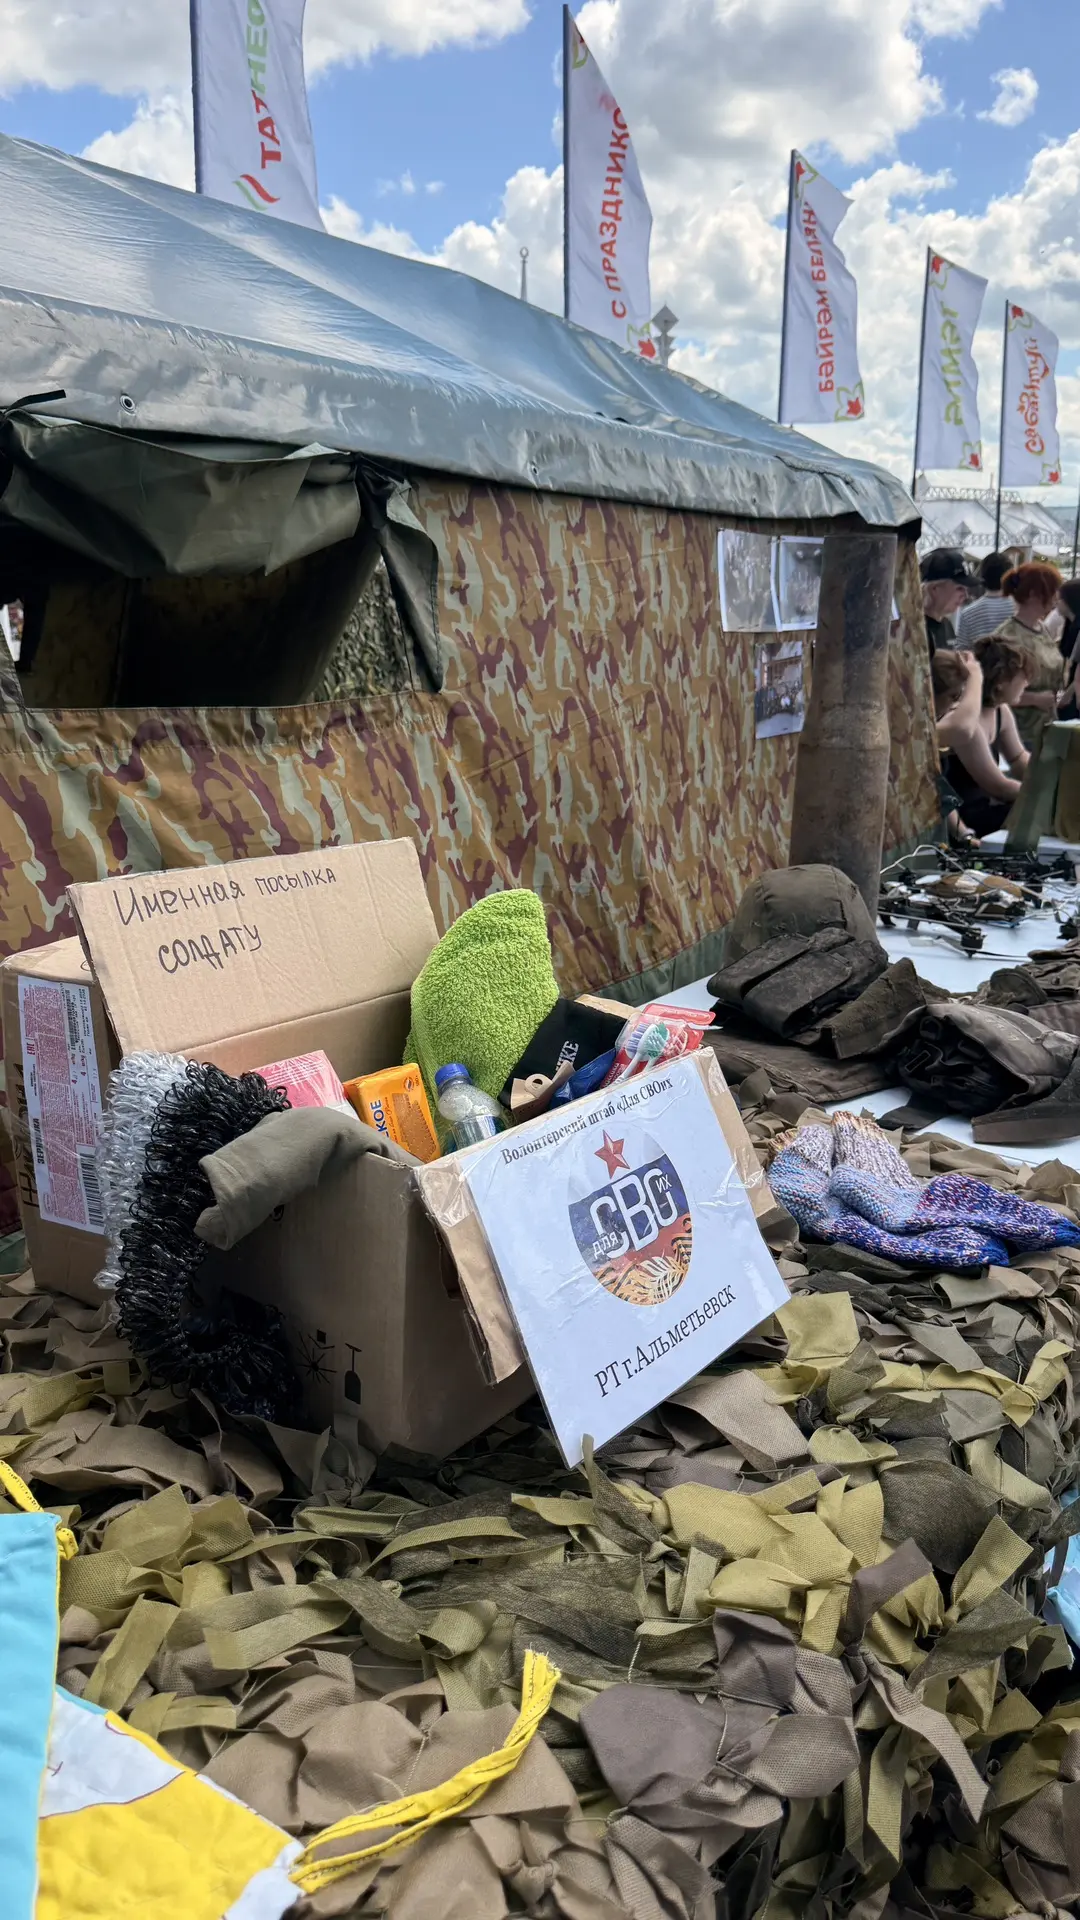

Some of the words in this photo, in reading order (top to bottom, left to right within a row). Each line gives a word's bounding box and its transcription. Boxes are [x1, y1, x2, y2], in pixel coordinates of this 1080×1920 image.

[611, 300, 627, 319] С
[113, 881, 246, 926] Именная
[370, 1099, 389, 1138] КОЕ
[500, 1115, 587, 1165] Волонтерский
[588, 1101, 616, 1126] штаб
[616, 1094, 641, 1114] «Для
[594, 1361, 622, 1397] РТ
